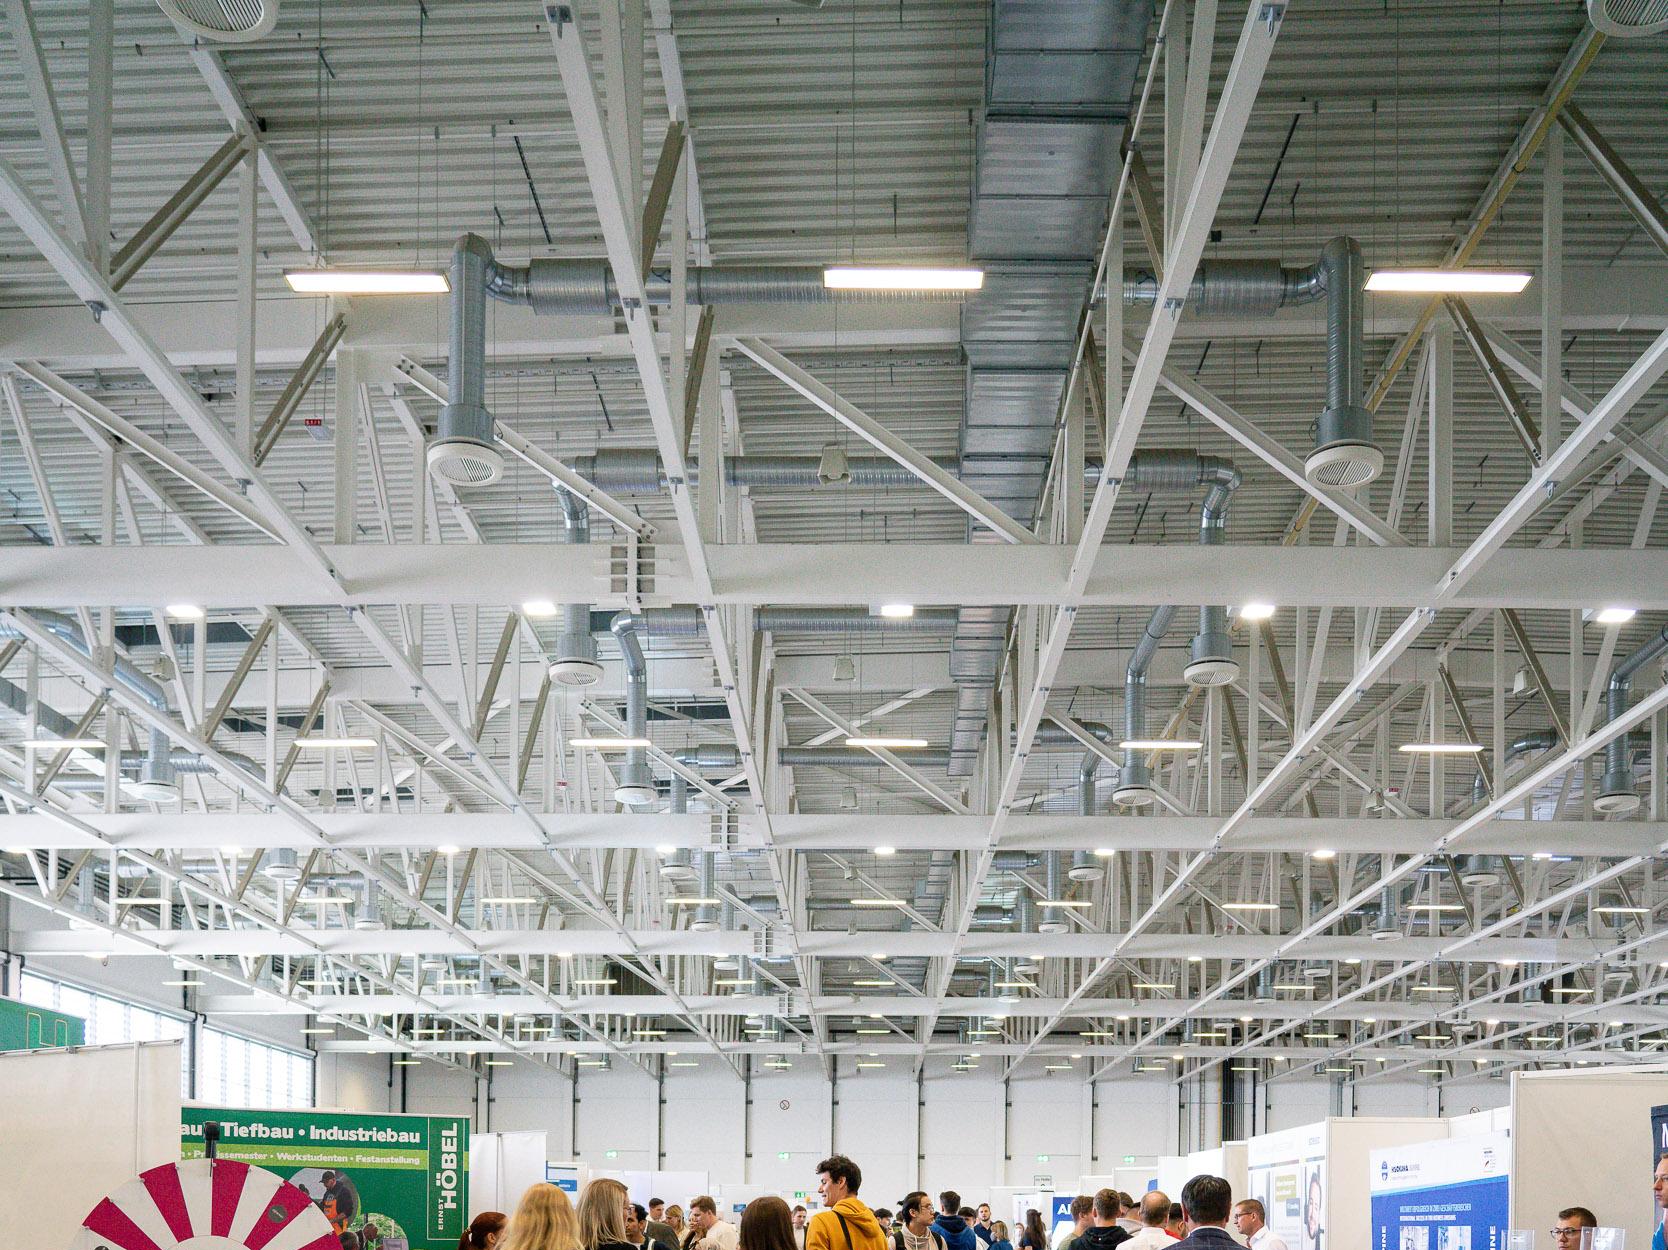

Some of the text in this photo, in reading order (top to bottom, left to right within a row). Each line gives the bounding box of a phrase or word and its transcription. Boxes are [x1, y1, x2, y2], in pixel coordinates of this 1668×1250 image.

[220, 1121, 294, 1139] Tiefbau
[310, 1125, 420, 1143] Industriebau
[276, 1152, 348, 1163] Werkstudenten
[355, 1154, 420, 1166] Festanstellung
[436, 1122, 458, 1209] HÖBEL
